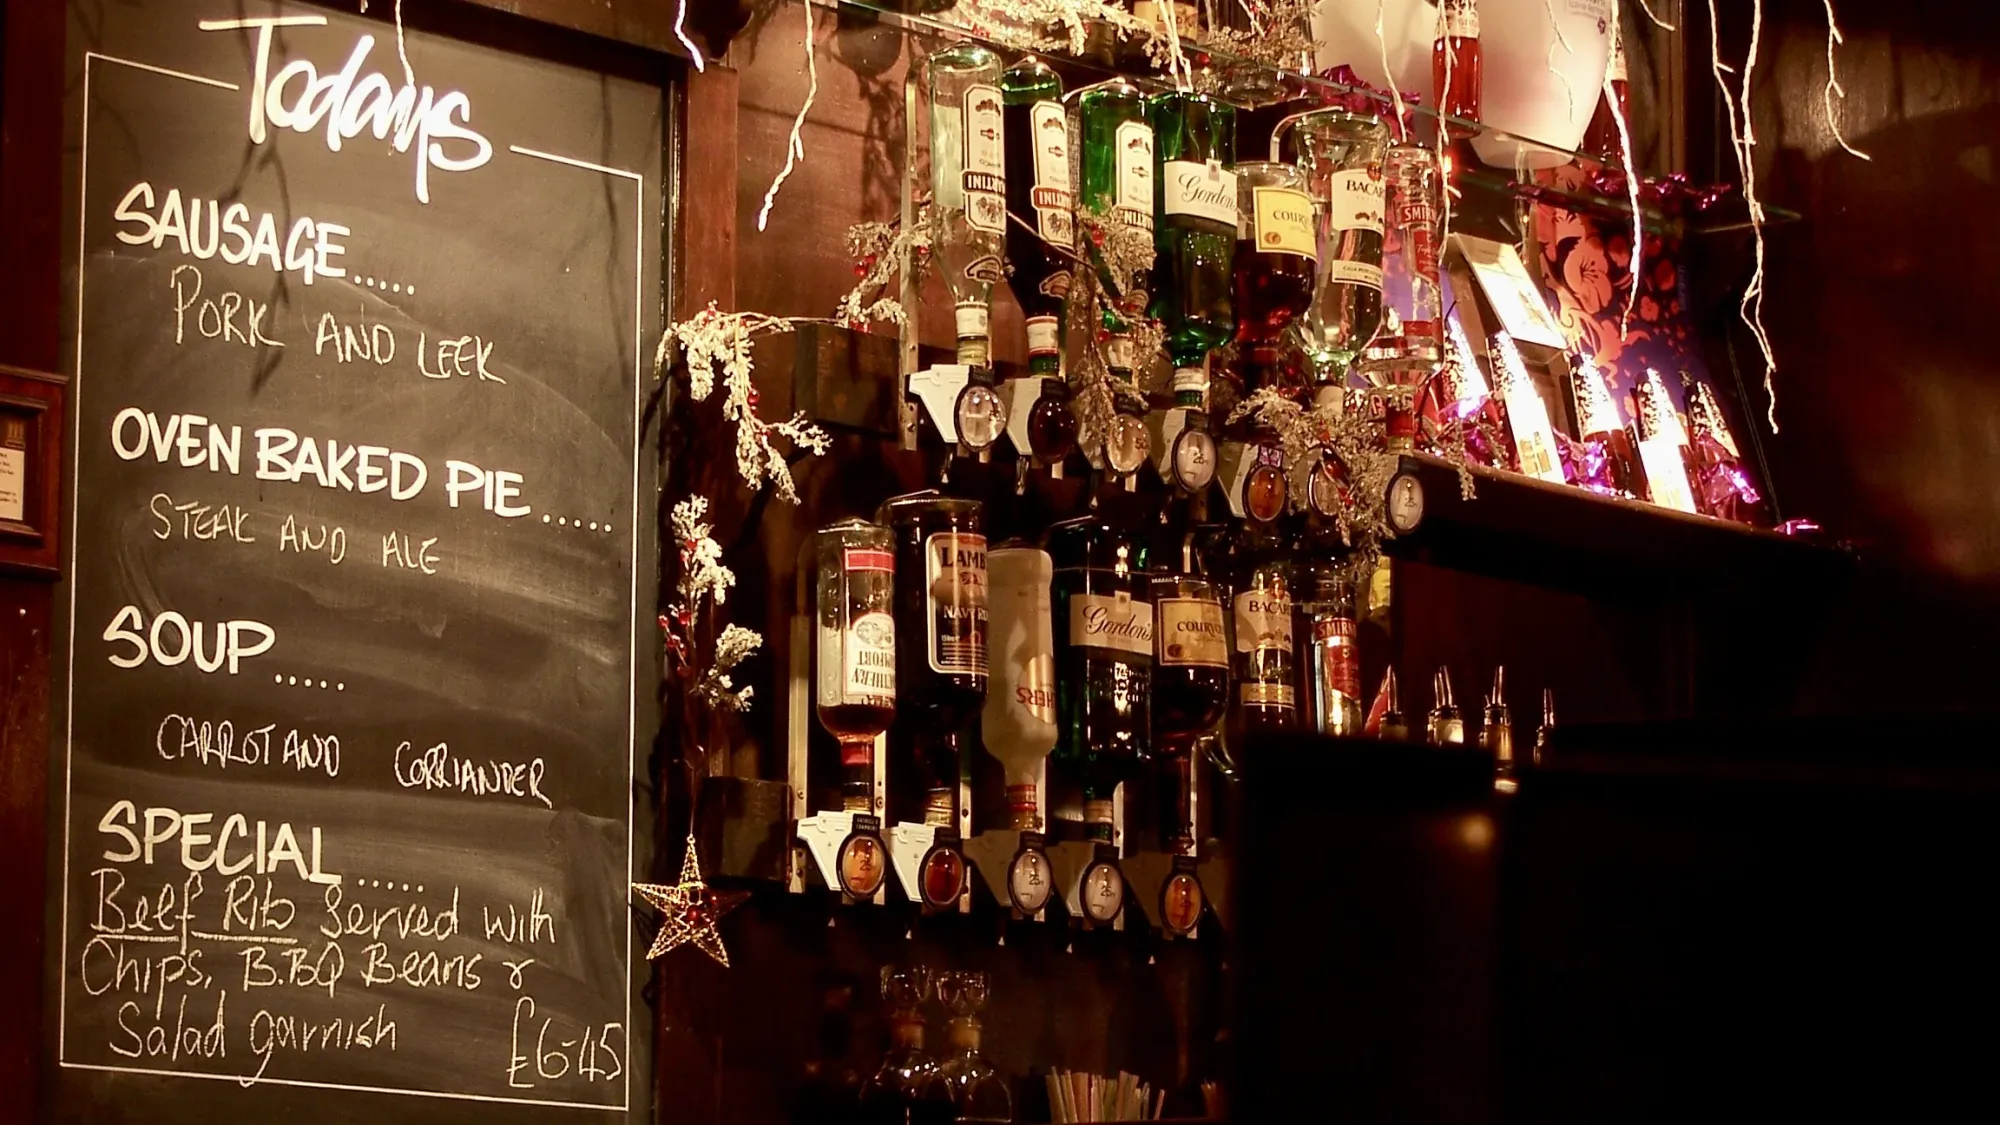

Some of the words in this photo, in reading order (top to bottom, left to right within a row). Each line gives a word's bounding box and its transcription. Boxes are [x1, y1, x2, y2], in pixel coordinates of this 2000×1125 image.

[199, 16, 493, 203] Todays
[171, 265, 283, 345] PORK
[315, 306, 396, 365] AND
[418, 332, 506, 383] LEEK
[111, 408, 241, 474] OVEN
[254, 428, 428, 501] BAKED
[149, 493, 256, 544] STEAK
[280, 513, 346, 564] AND
[382, 530, 440, 575] ALE
[157, 714, 276, 769] CARROT
[283, 728, 340, 777] AND
[90, 871, 204, 955] Beef
[224, 875, 296, 931] Rib
[320, 884, 459, 941] Served
[361, 942, 483, 990] Beans
[109, 990, 226, 1062] Salad
[238, 1003, 397, 1088] garnish
